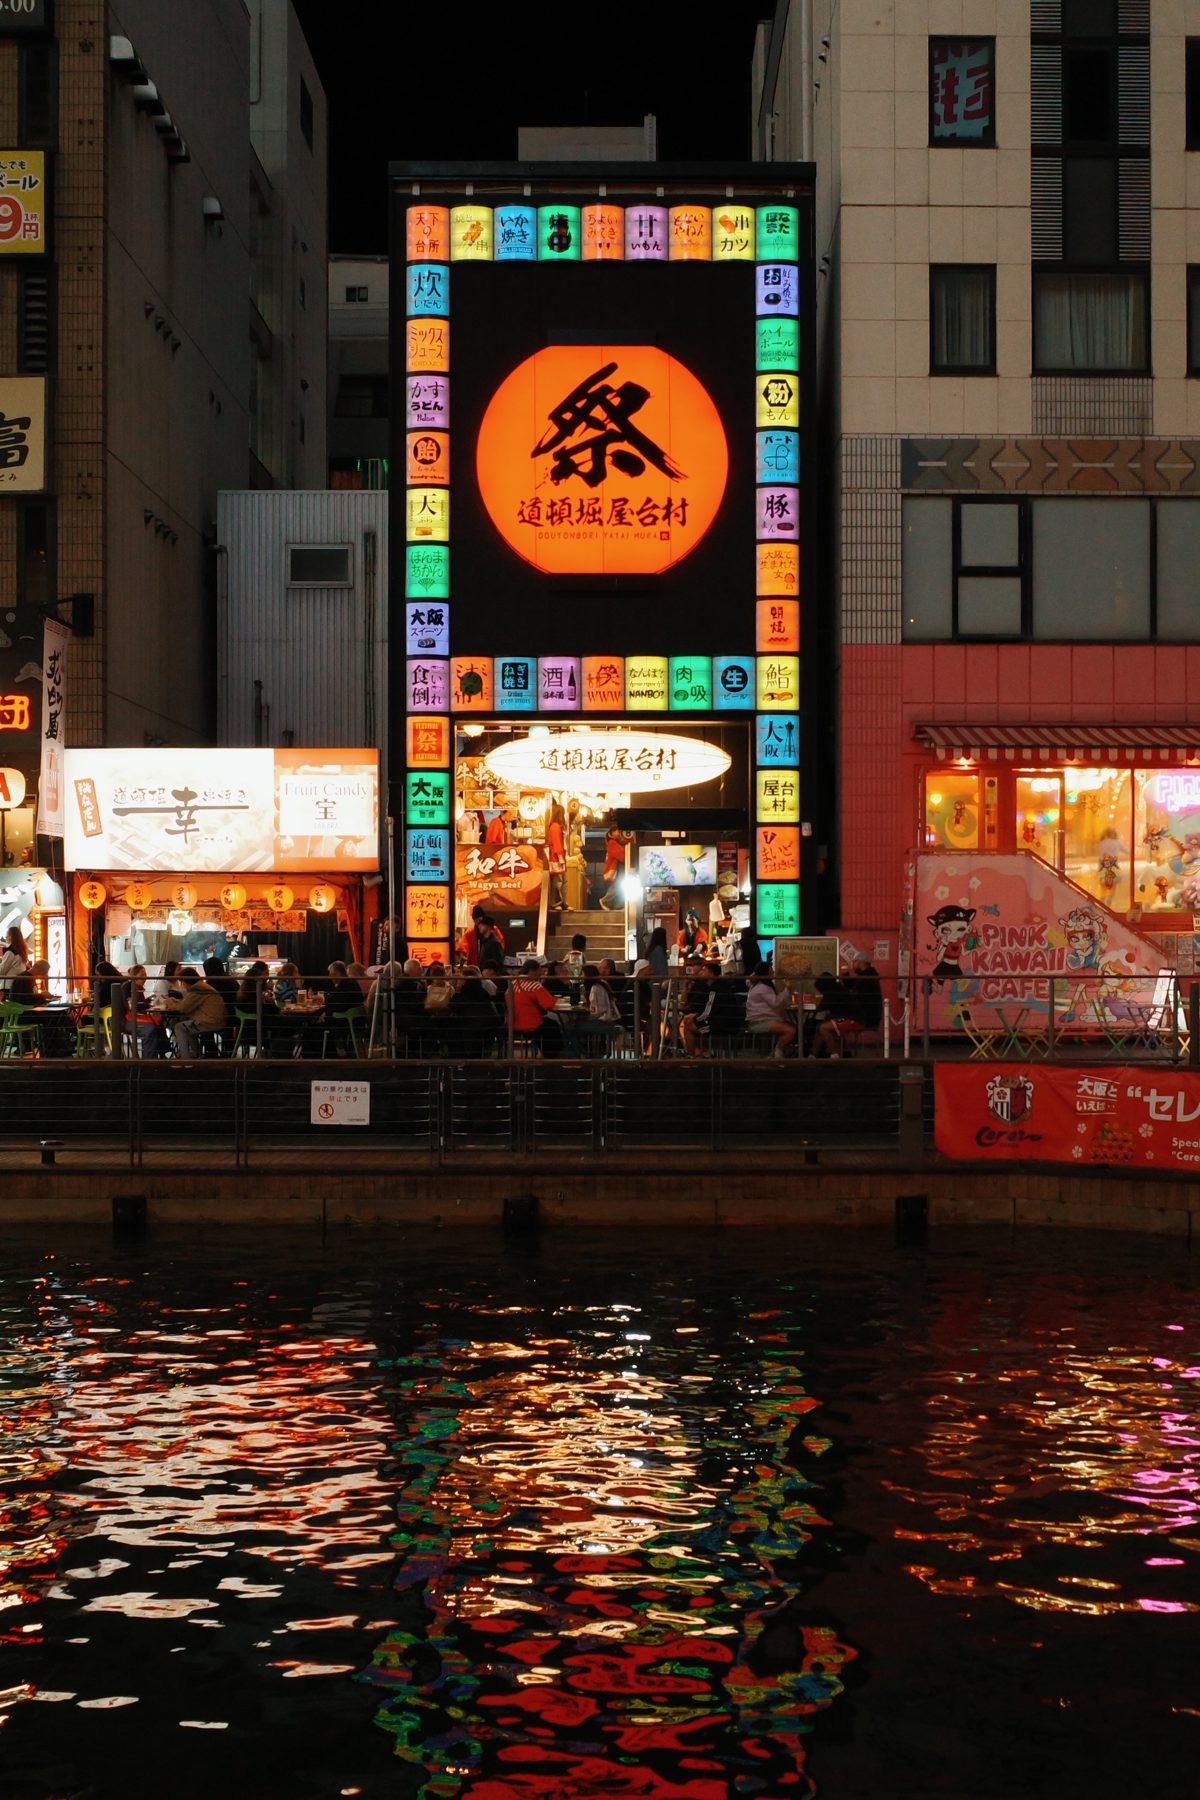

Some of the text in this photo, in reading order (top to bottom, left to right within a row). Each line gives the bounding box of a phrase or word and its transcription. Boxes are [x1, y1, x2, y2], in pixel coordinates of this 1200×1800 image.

[416, 212, 439, 226] 天下
[501, 214, 529, 227] いか
[766, 212, 791, 222] ほな
[22, 222, 40, 239] 円
[501, 228, 530, 244] 焼き
[416, 240, 439, 253] 台所
[720, 238, 749, 252] カツ
[411, 326, 443, 344] ミックス
[761, 326, 782, 337] ハイ
[411, 345, 443, 359] ジュース
[411, 381, 445, 399] かす
[411, 401, 444, 411] うどん
[766, 408, 790, 420] もん
[531, 362, 689, 488] 祭
[765, 435, 792, 444] バード
[517, 497, 689, 527] 道頓堀屋台村
[765, 493, 790, 518] 豚
[411, 551, 443, 564] ほんま
[411, 564, 443, 577] あかん
[411, 608, 444, 626] 大阪
[411, 628, 443, 636] スイーツ
[504, 664, 526, 676] ねぎ
[543, 667, 563, 687] 酒
[676, 666, 692, 683] 肉
[766, 664, 791, 688] 鮨
[504, 677, 525, 688] 焼き
[725, 670, 744, 688] 生
[690, 685, 708, 702] 吸
[539, 748, 677, 771] 道頓堀屋台村
[284, 782, 369, 799] Fruit Candy
[412, 778, 444, 798] 大阪
[763, 780, 794, 796] 屋台
[314, 798, 338, 820] 宝
[772, 797, 787, 812] 村
[466, 849, 529, 878] 和牛
[469, 881, 521, 890] Wagyu Beef
[982, 923, 1049, 949] PINK
[971, 947, 1067, 973] KAWAII
[984, 978, 1049, 1000] CAFE
[1077, 1078, 1118, 1098] 大阪と
[1172, 1137, 1200, 1149] Spea
